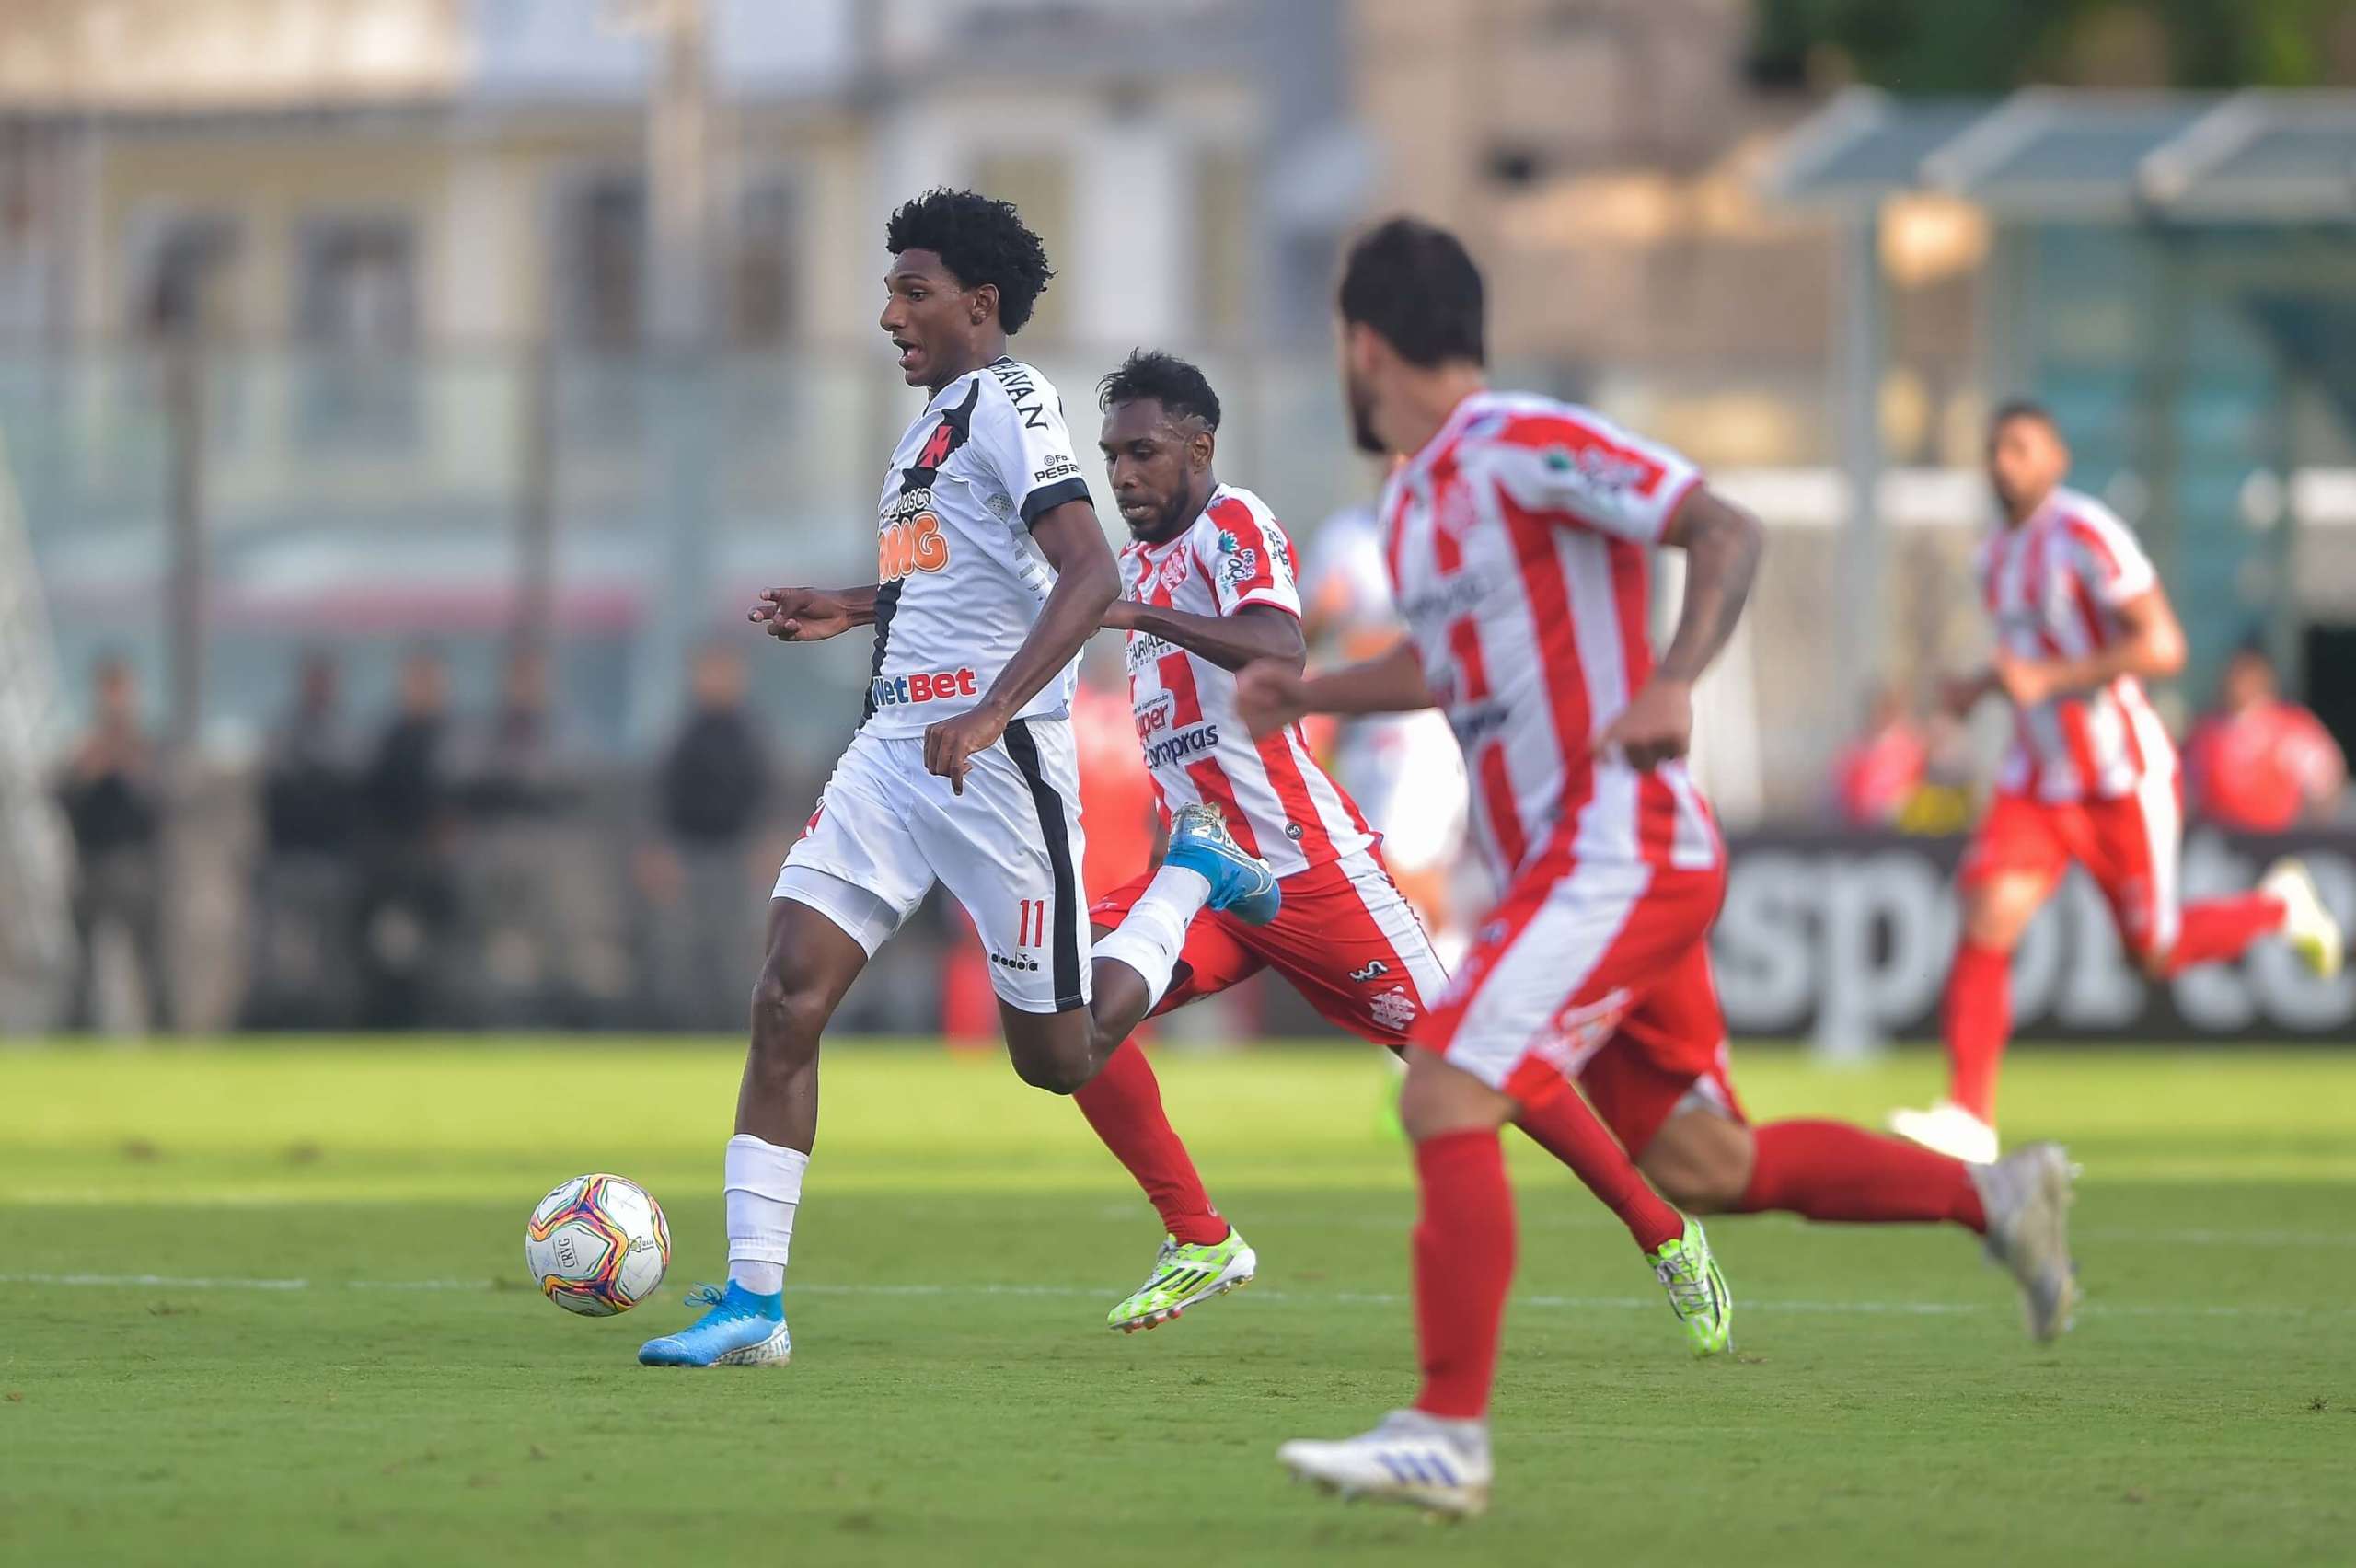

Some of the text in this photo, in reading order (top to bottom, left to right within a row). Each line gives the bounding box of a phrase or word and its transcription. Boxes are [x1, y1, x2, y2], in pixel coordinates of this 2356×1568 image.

[872, 668, 976, 707] NetBet
[1135, 703, 1169, 738] uper
[1019, 898, 1045, 948] 11
